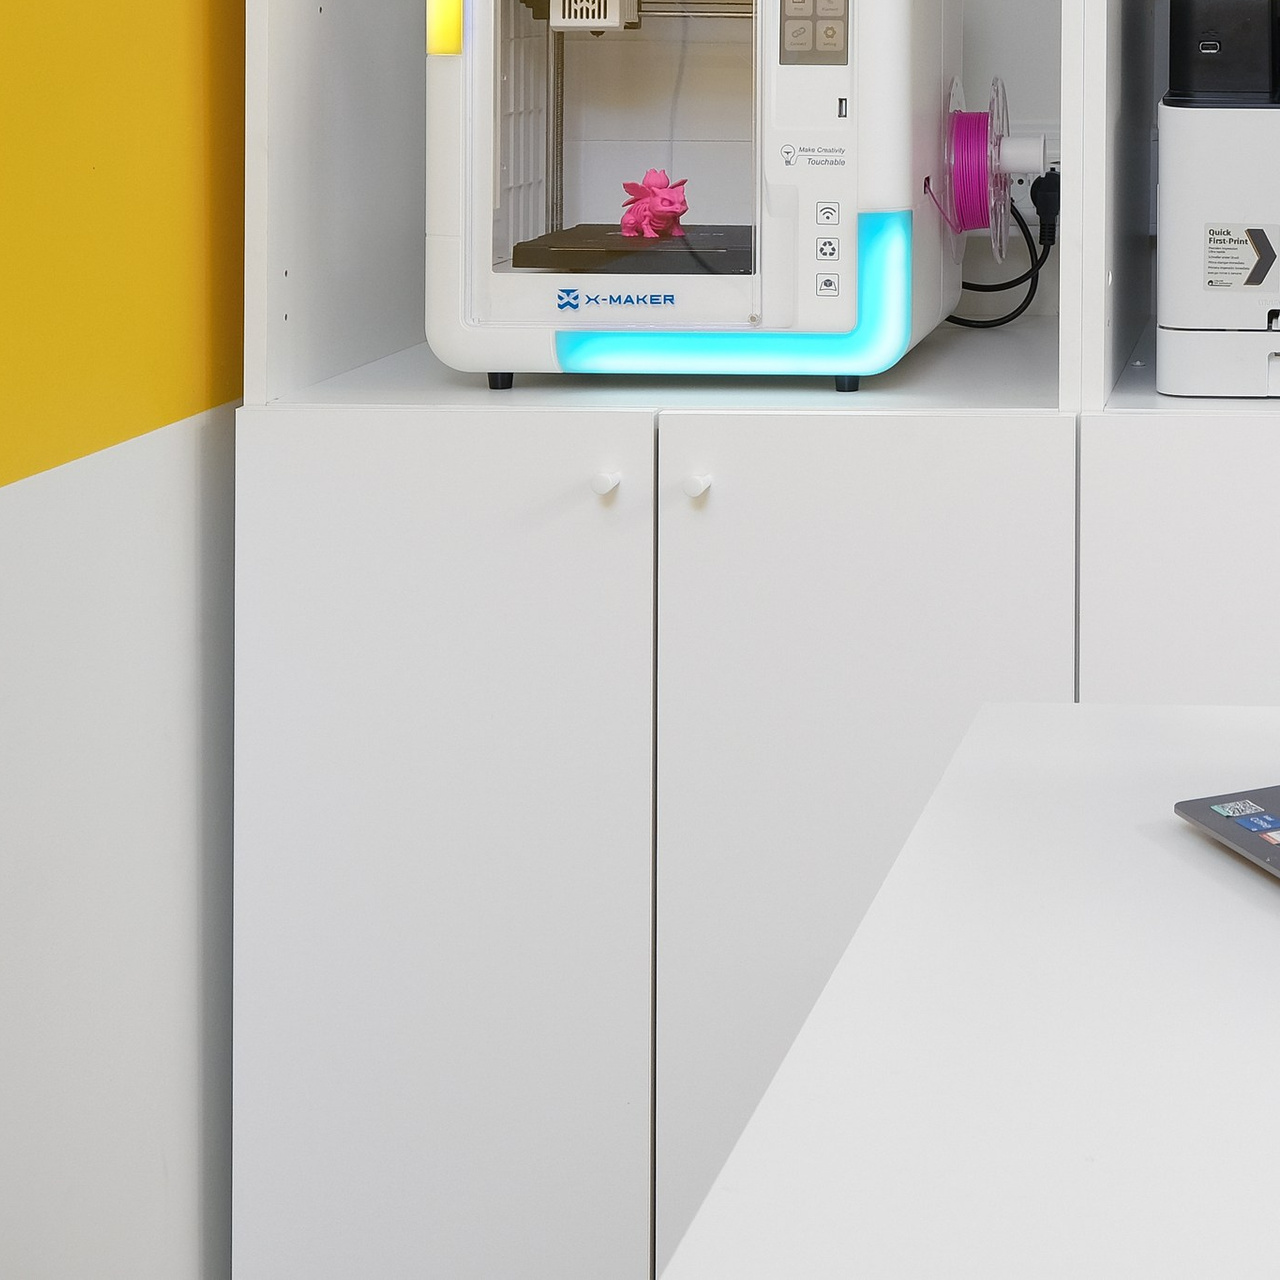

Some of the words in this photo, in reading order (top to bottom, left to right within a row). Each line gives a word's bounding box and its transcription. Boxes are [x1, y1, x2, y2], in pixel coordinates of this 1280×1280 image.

[816, 146, 846, 154] Creativity
[807, 157, 846, 166] Touchable
[1208, 228, 1232, 236] Quick
[1208, 237, 1249, 245] First-Print
[584, 294, 675, 305] X-MAKER
